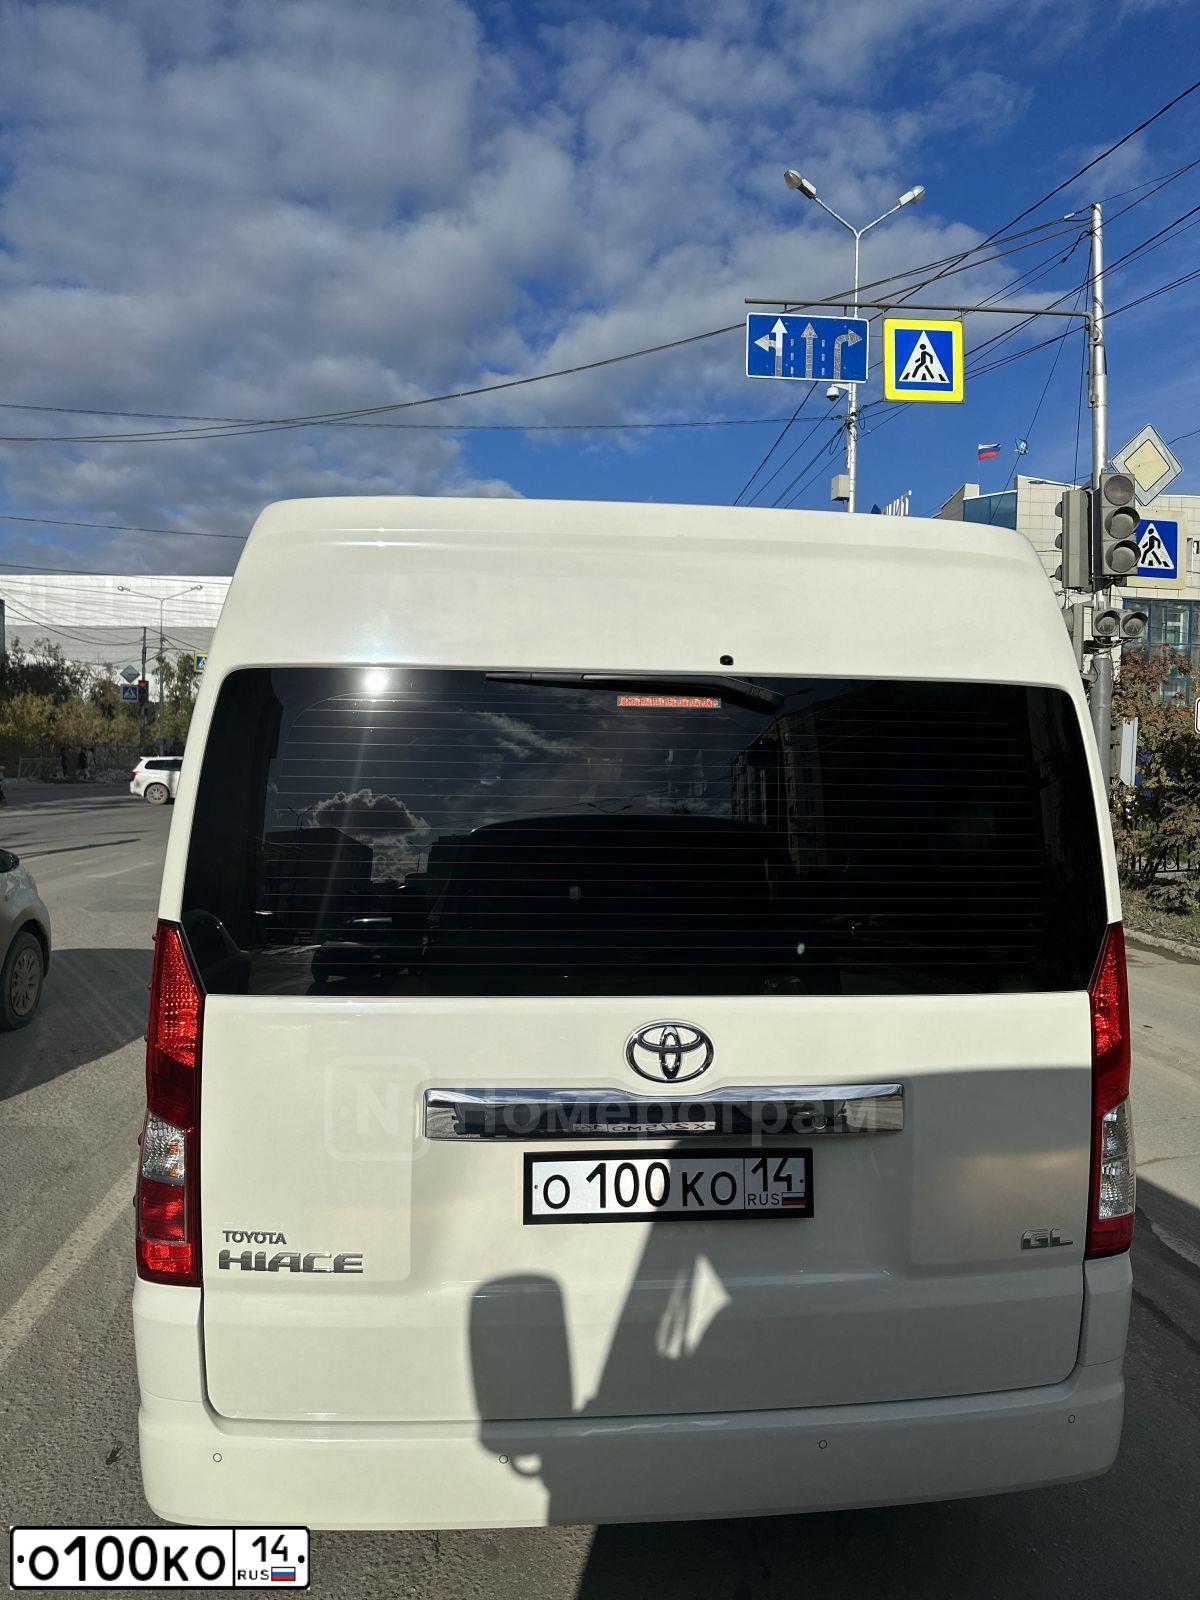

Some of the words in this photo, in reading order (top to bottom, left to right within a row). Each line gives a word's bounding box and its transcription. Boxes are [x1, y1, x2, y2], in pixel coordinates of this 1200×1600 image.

[751, 1157, 793, 1192] 14
[747, 1193, 780, 1206] RUS
[222, 1230, 287, 1245] TOYOTA
[1021, 1228, 1073, 1250] GL
[218, 1249, 364, 1274] HIACE
